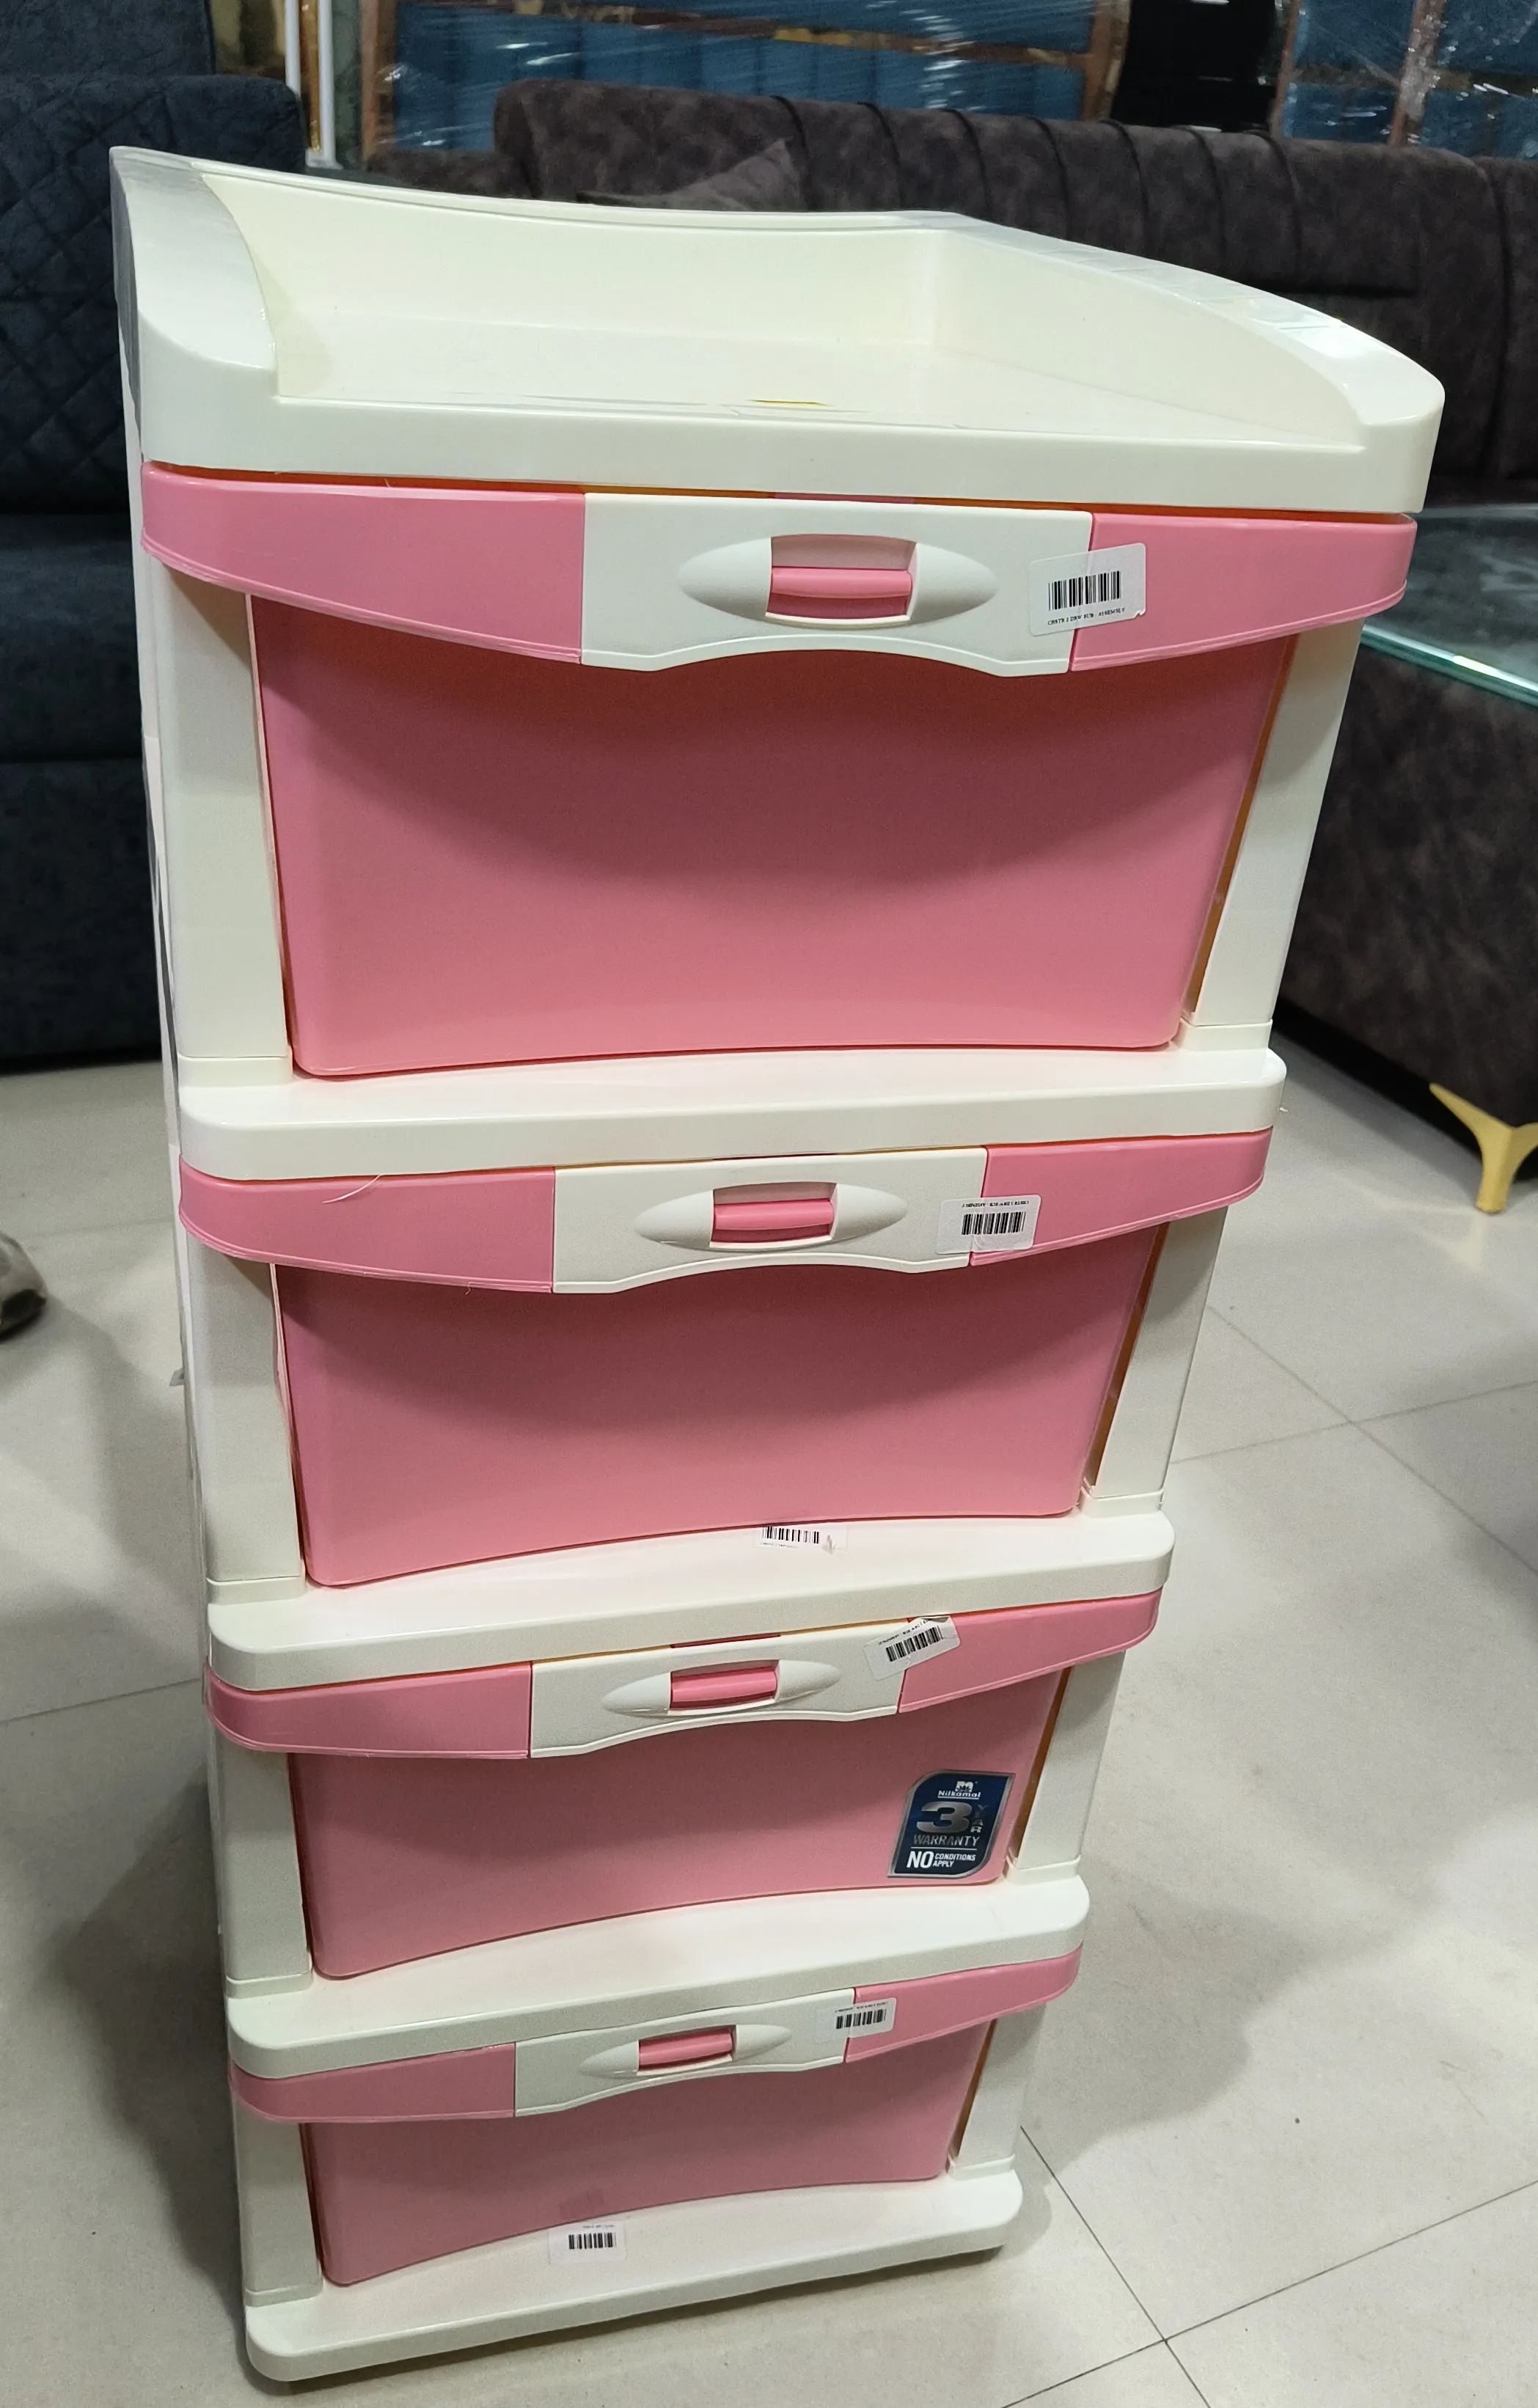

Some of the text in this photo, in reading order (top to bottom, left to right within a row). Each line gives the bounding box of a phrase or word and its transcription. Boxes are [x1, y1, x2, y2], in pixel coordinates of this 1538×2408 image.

[937, 1790, 981, 1798] Nilkamal
[916, 1801, 973, 1833] 3
[913, 1834, 980, 1846] WARRANTY
[906, 1851, 934, 1868] NO
[934, 1852, 976, 1861] CONDITIONS
[933, 1860, 955, 1868] APPLY
